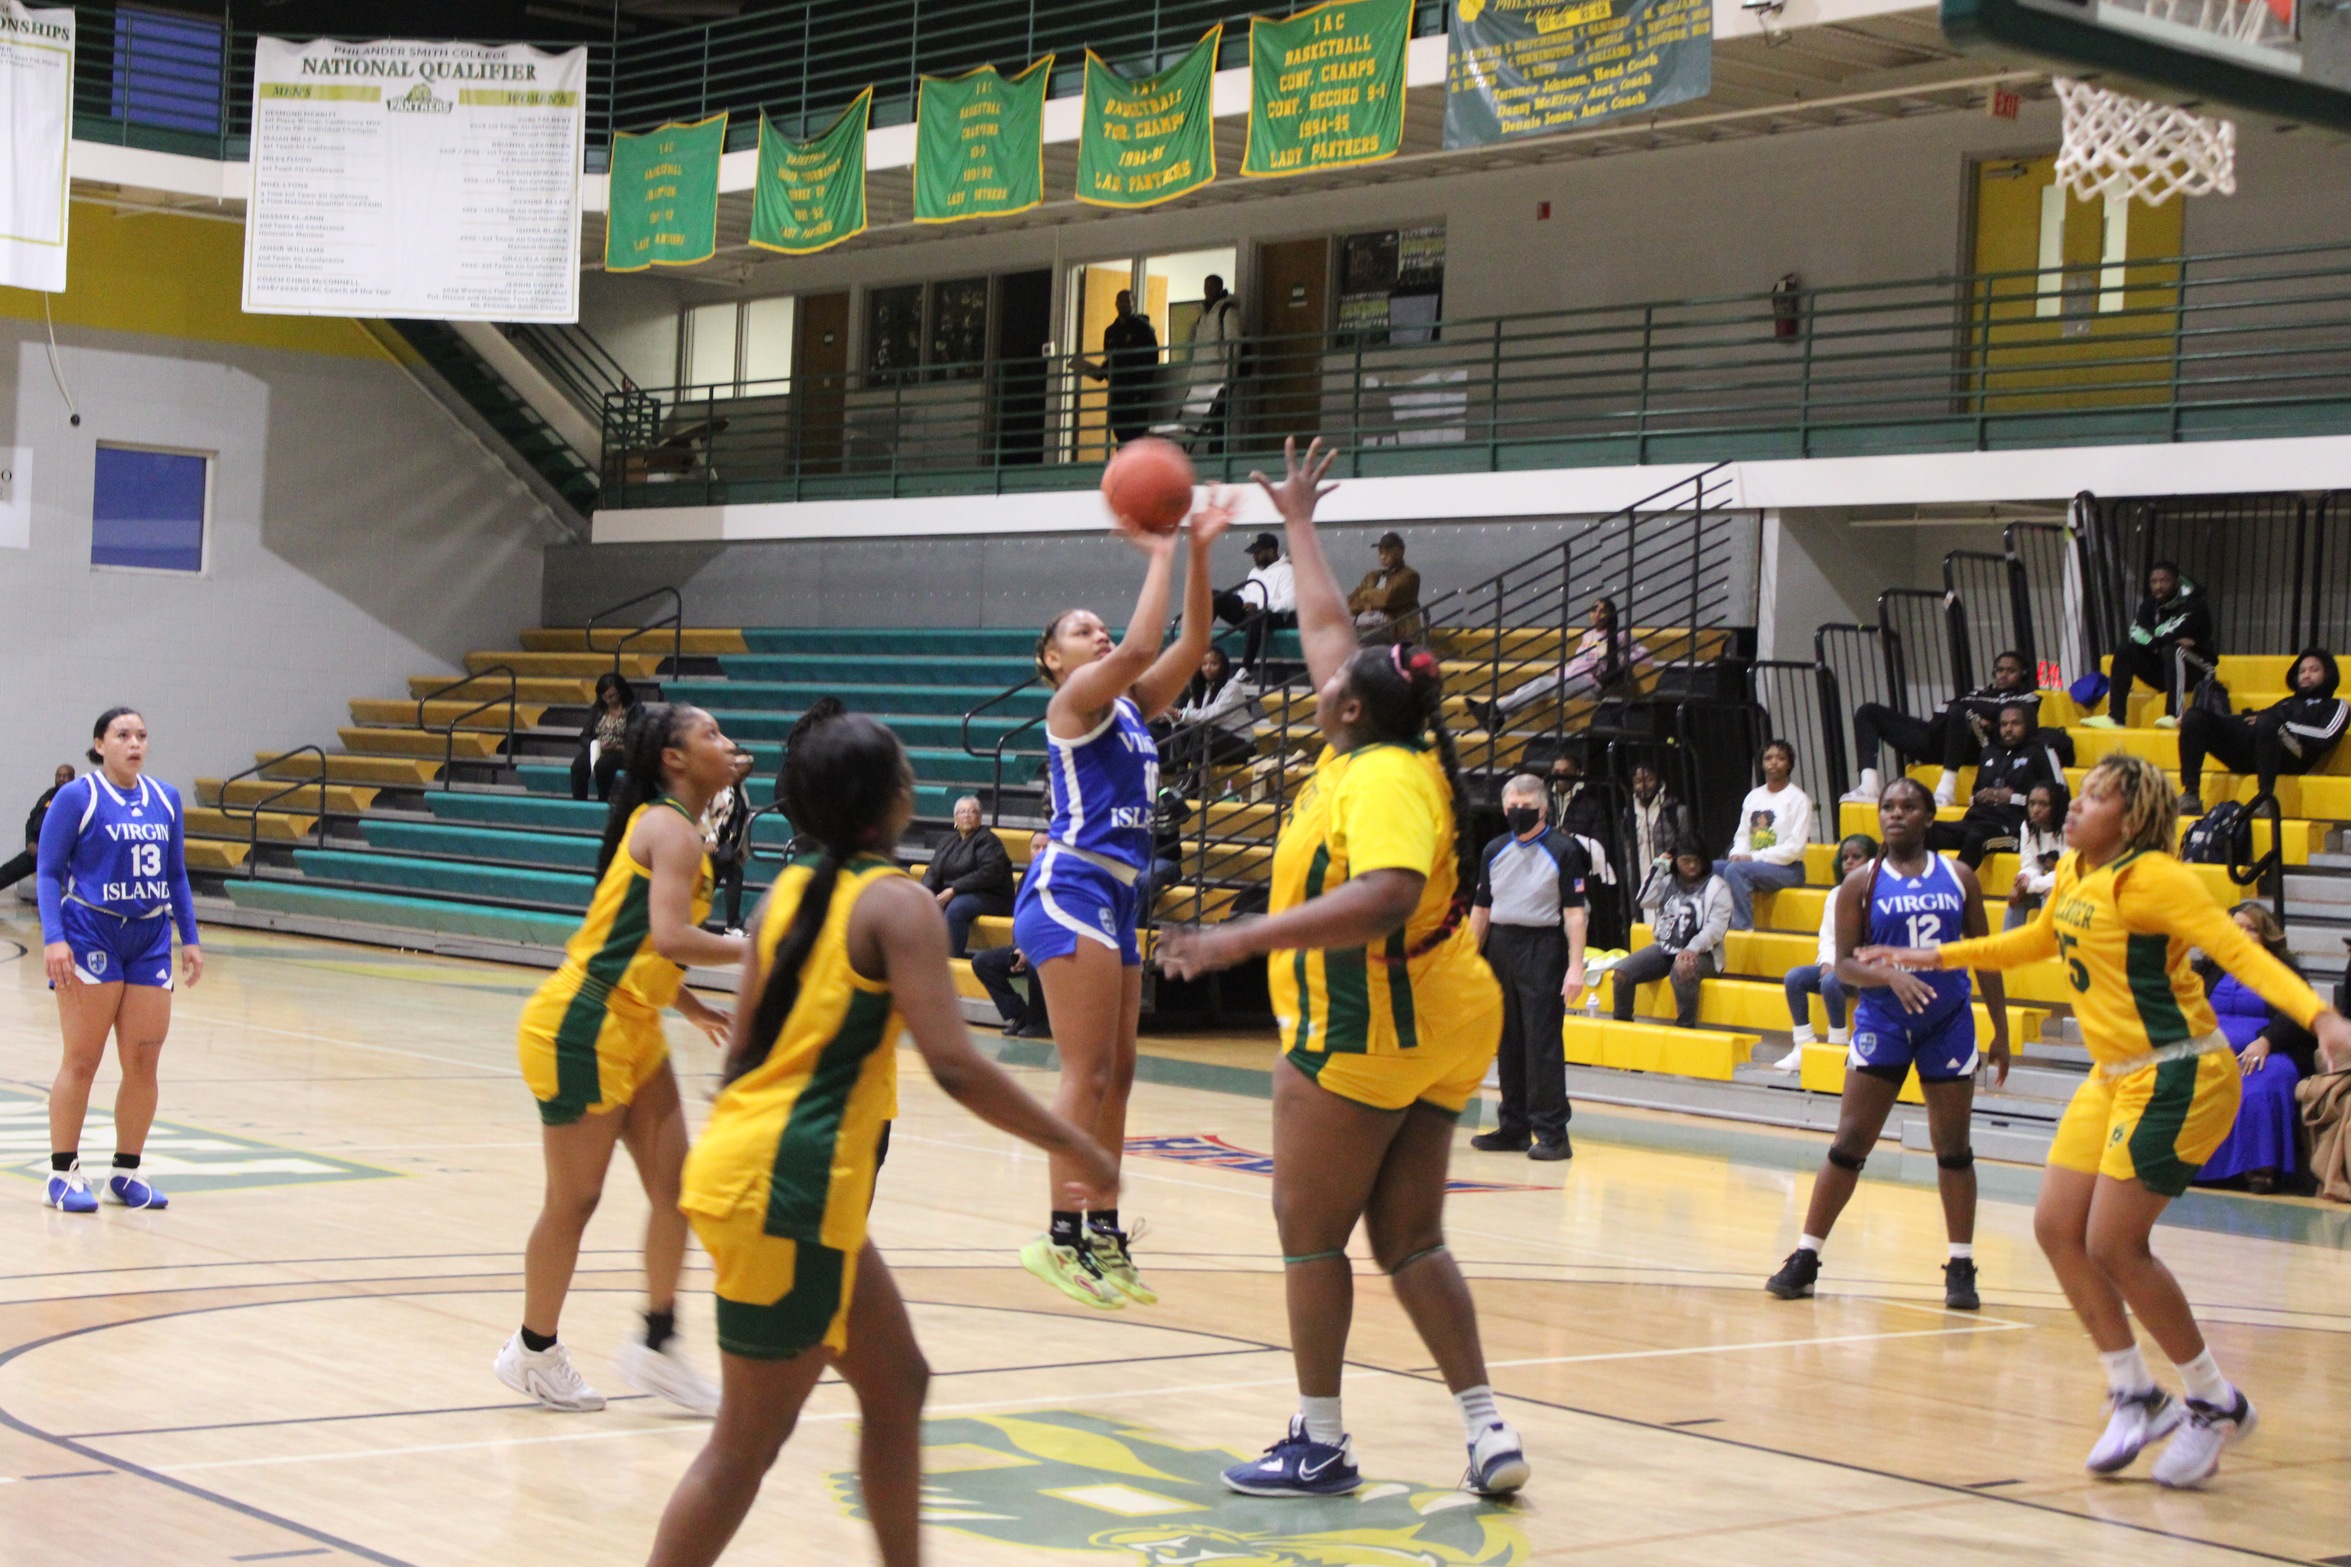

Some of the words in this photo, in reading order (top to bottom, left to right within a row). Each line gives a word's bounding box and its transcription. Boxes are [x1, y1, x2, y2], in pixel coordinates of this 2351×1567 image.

[333, 45, 405, 57] PHILANDER
[409, 48, 447, 59] SMITH
[452, 48, 508, 60] COLLEGE
[1285, 34, 1372, 67] BASKETBALL
[301, 57, 414, 78] NATIONAL
[419, 61, 537, 82] QUALIFIER
[1280, 69, 1314, 92] CONF.
[1321, 58, 1376, 83] CHAMPS
[1542, 74, 1591, 93] Johnson,
[1593, 62, 1624, 82] Head
[1627, 51, 1659, 74] Coach
[1619, 71, 1653, 91] Coach
[1267, 97, 1303, 119] CONF.
[1309, 87, 1359, 111] RECORD
[1501, 115, 1541, 134] Dennis
[1611, 90, 1647, 110] Coach
[1270, 147, 1303, 169] LADY
[1311, 135, 1379, 160] PANTHERS
[105, 823, 169, 842] VIRGIN
[131, 843, 161, 877] 13
[103, 881, 170, 901] ISLAND
[1877, 892, 1960, 915] VIRGIN
[1906, 913, 1942, 949] 12
